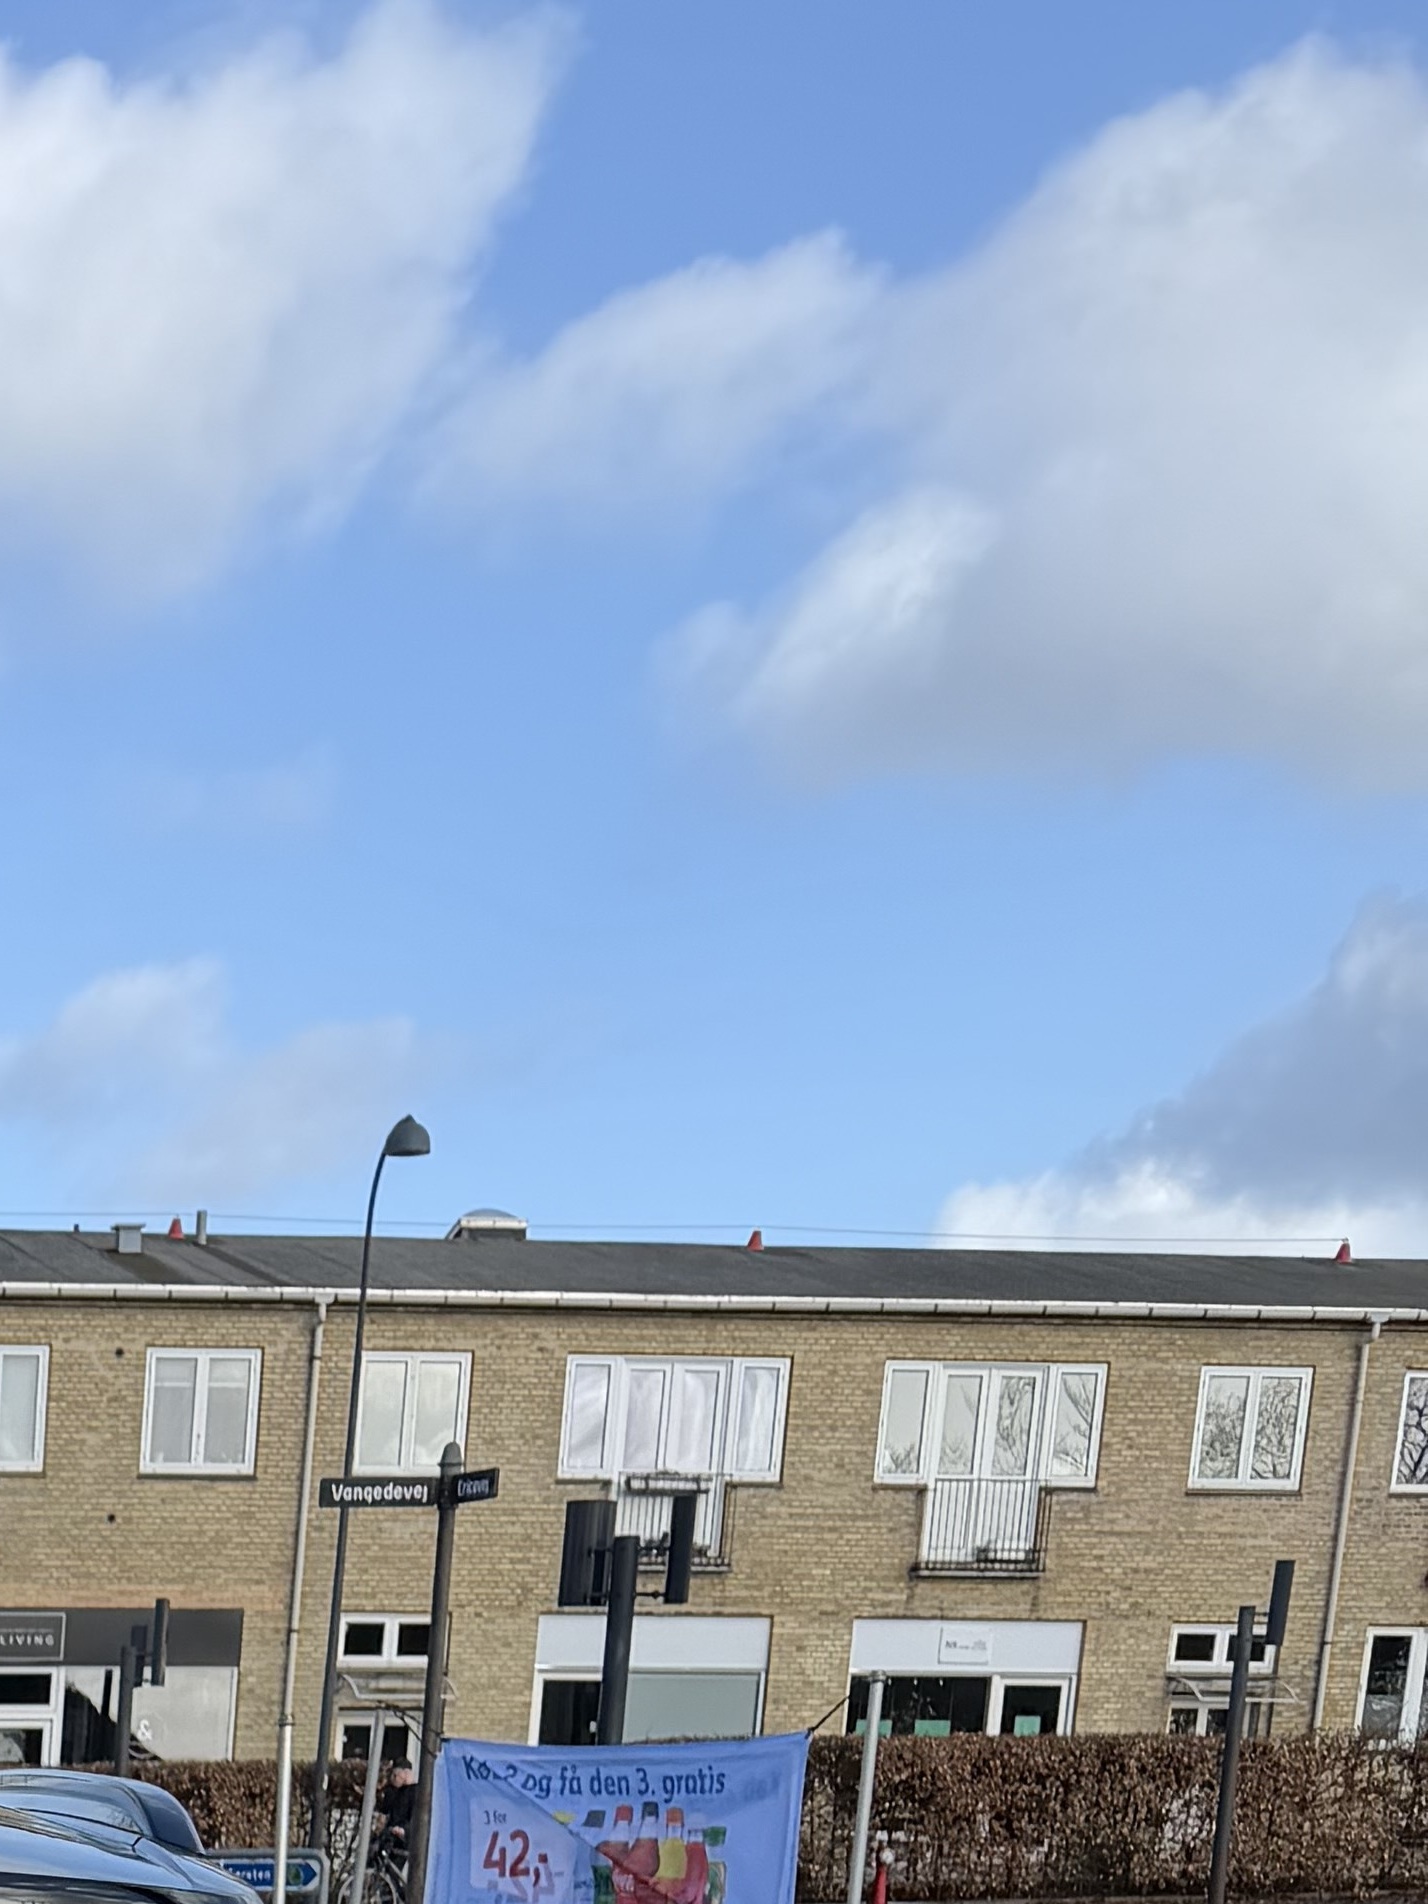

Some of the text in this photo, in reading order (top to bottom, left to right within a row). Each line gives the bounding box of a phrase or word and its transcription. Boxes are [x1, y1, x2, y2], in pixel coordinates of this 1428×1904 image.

[331, 1482, 428, 1504] Vangedevej
[462, 1755, 502, 1781] Kø
[560, 1764, 582, 1796] få
[590, 1766, 630, 1796] den
[636, 1767, 656, 1796] 3.
[662, 1765, 726, 1803] gratis
